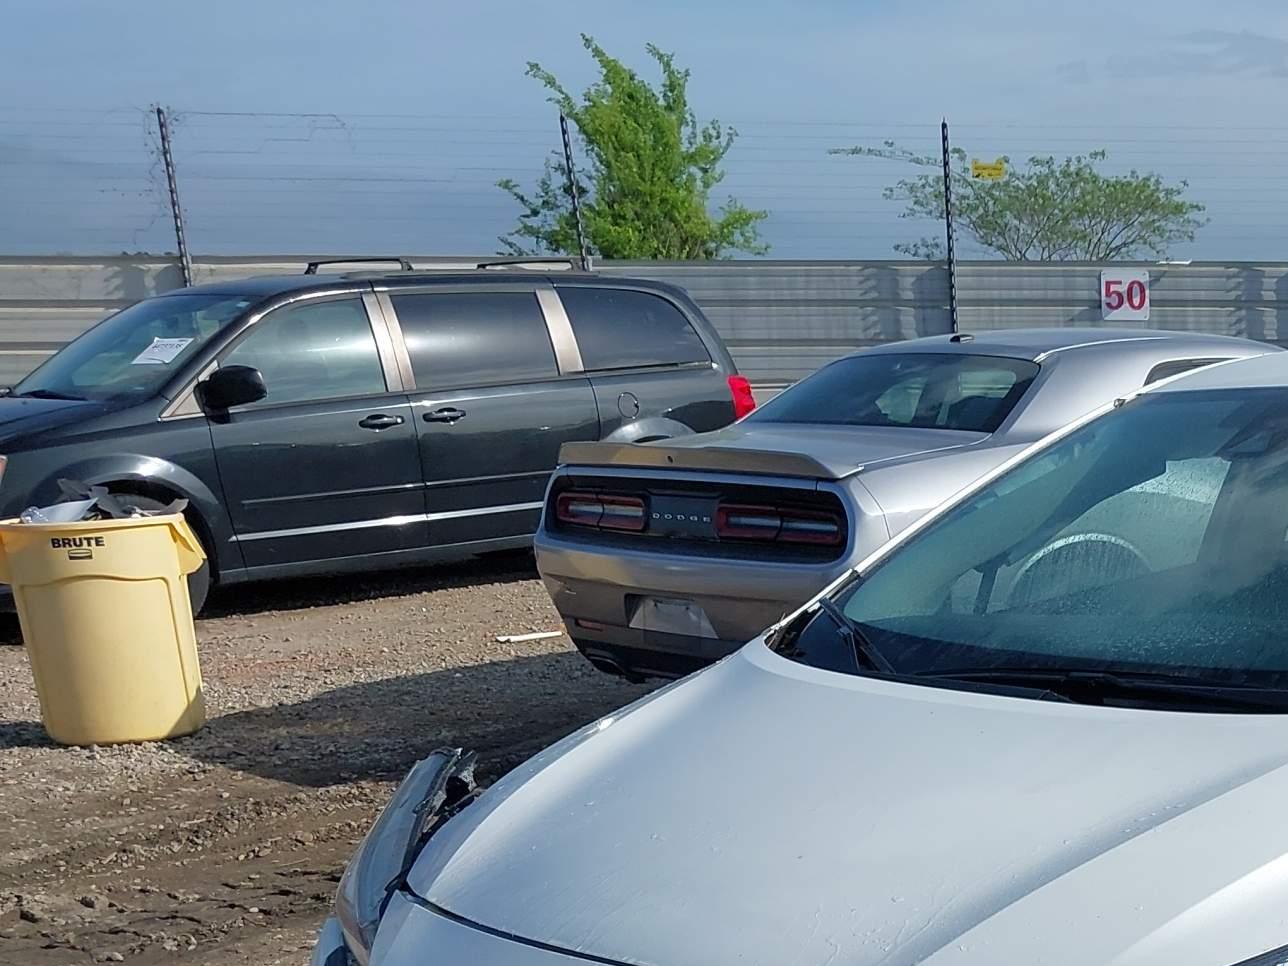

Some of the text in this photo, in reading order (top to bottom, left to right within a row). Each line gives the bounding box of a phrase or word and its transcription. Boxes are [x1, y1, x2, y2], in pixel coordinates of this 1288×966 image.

[1104, 280, 1146, 311] 50
[652, 512, 712, 523] DODGE
[50, 536, 105, 549] BRUTE
